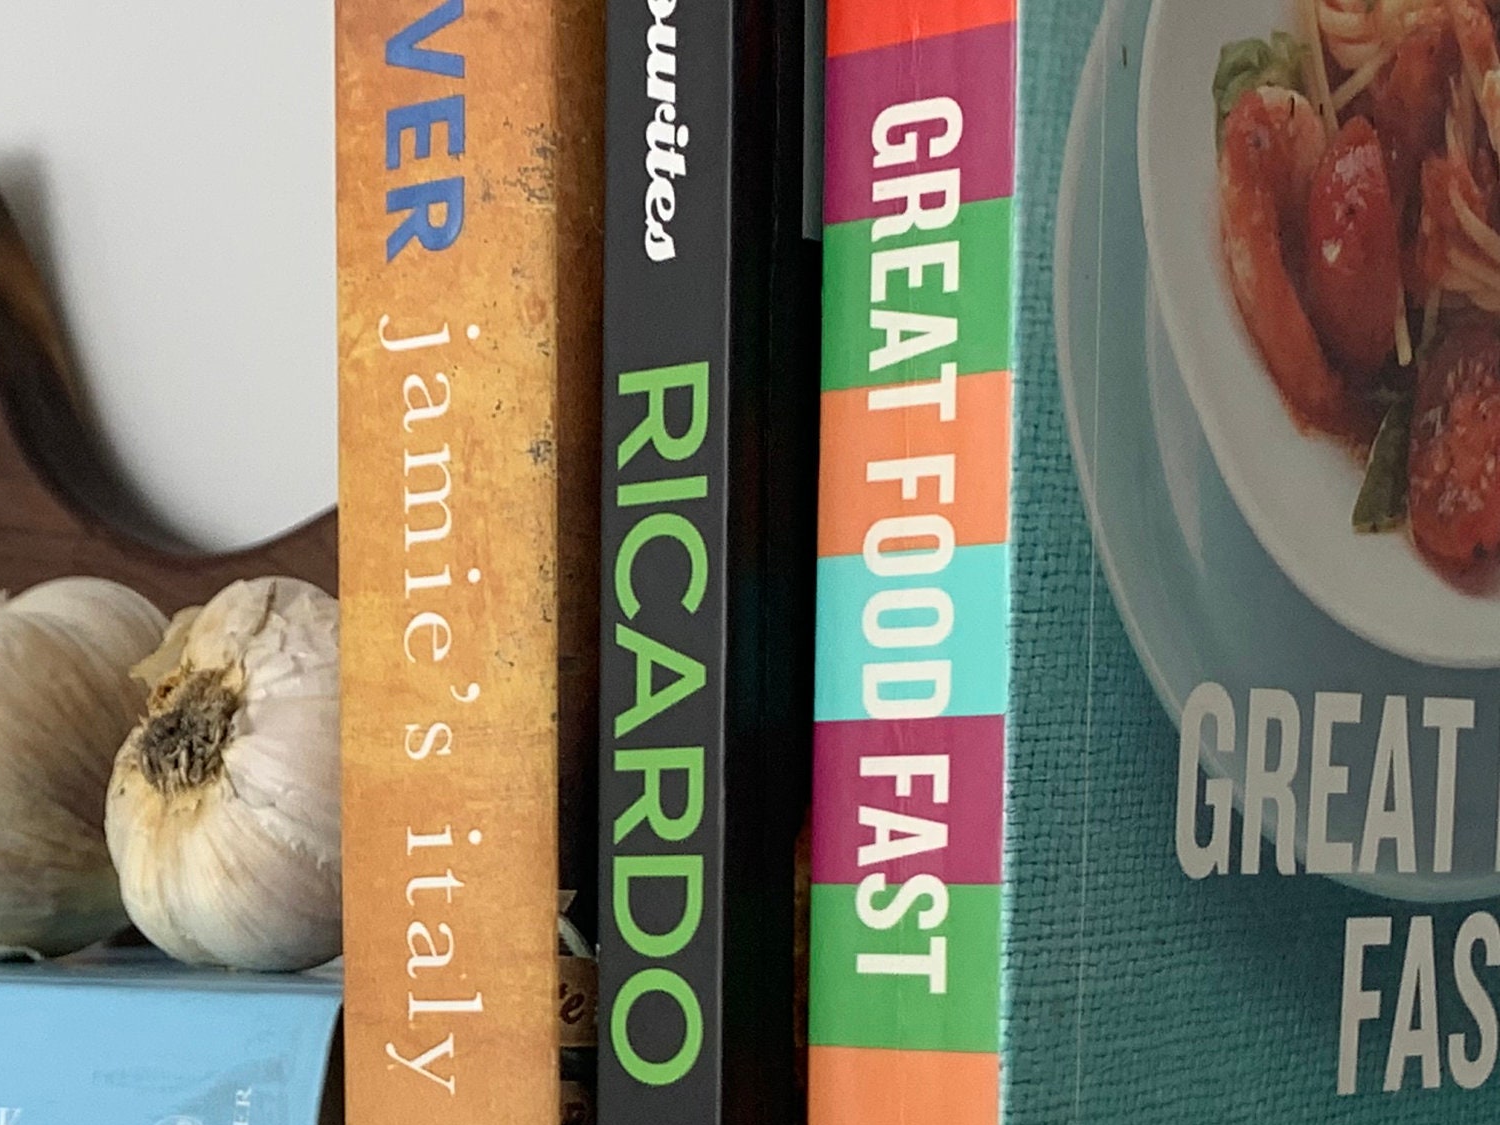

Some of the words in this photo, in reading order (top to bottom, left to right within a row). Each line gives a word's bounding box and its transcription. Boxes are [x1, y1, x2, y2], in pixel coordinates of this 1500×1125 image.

[386, 0, 465, 263] VER
[867, 97, 963, 422] GREAT
[378, 312, 481, 760] jamie's
[861, 453, 956, 720] FOOD
[610, 360, 710, 1086] RICARDO
[1175, 681, 1475, 880] GREAT
[385, 822, 484, 1096] italy
[855, 754, 950, 994] FAST
[1336, 910, 1500, 1096] FAS
